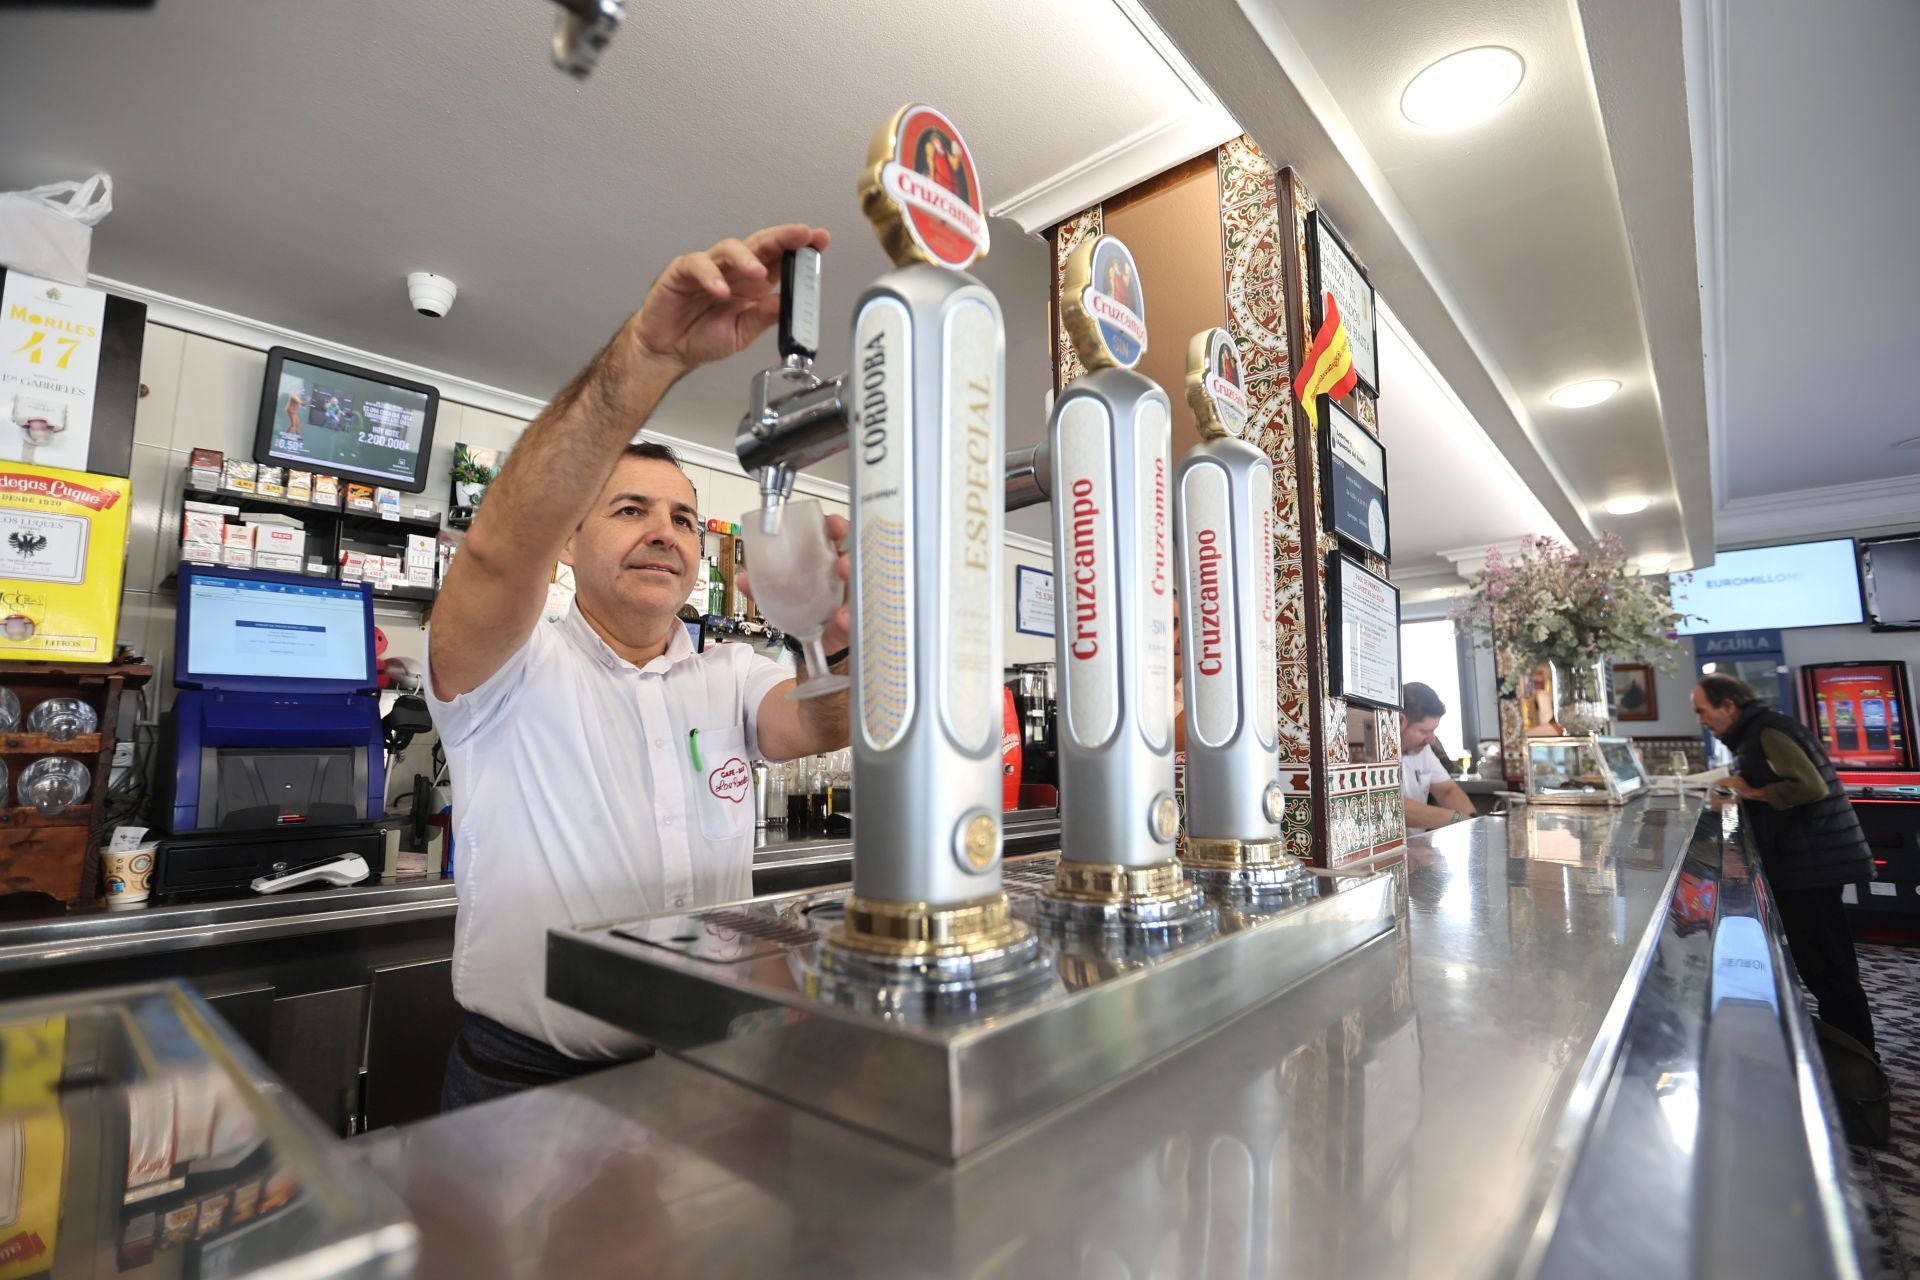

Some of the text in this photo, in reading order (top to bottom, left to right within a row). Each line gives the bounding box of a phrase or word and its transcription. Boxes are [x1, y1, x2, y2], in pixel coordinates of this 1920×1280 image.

[20, 377, 86, 397] GABRIELES
[2, 493, 35, 503] DESDE
[46, 480, 101, 504] Luque
[965, 374, 992, 571] ESPECIAL
[21, 518, 64, 529] LUQUES
[1150, 456, 1166, 596] Cruzcampo
[1072, 479, 1099, 660] Cruzcampo
[1200, 529, 1222, 676] Cruzcampo
